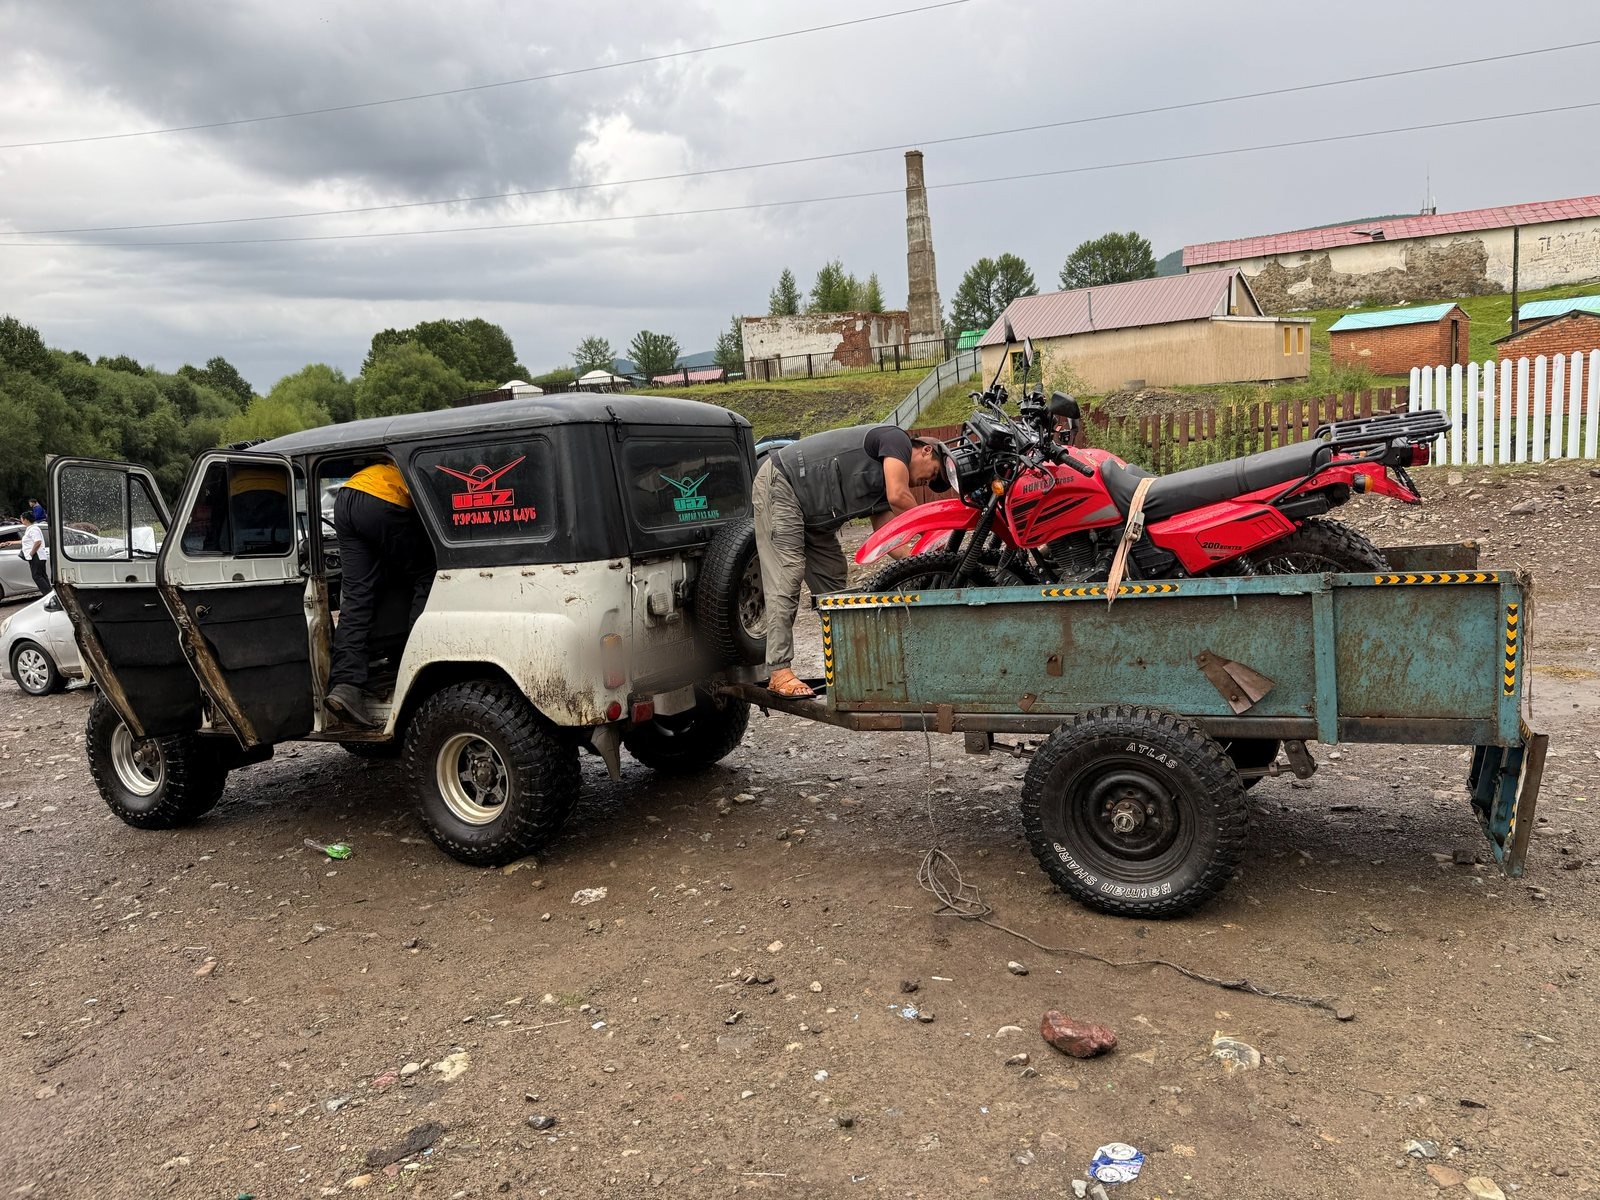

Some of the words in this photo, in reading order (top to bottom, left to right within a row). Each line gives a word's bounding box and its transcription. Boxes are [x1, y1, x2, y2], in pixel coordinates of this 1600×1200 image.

[493, 509, 511, 525] УАЗ
[1201, 541, 1220, 550] 200
[1125, 742, 1178, 769] ATLAS
[1053, 842, 1098, 886] SHARP
[1100, 882, 1172, 898] Batman
